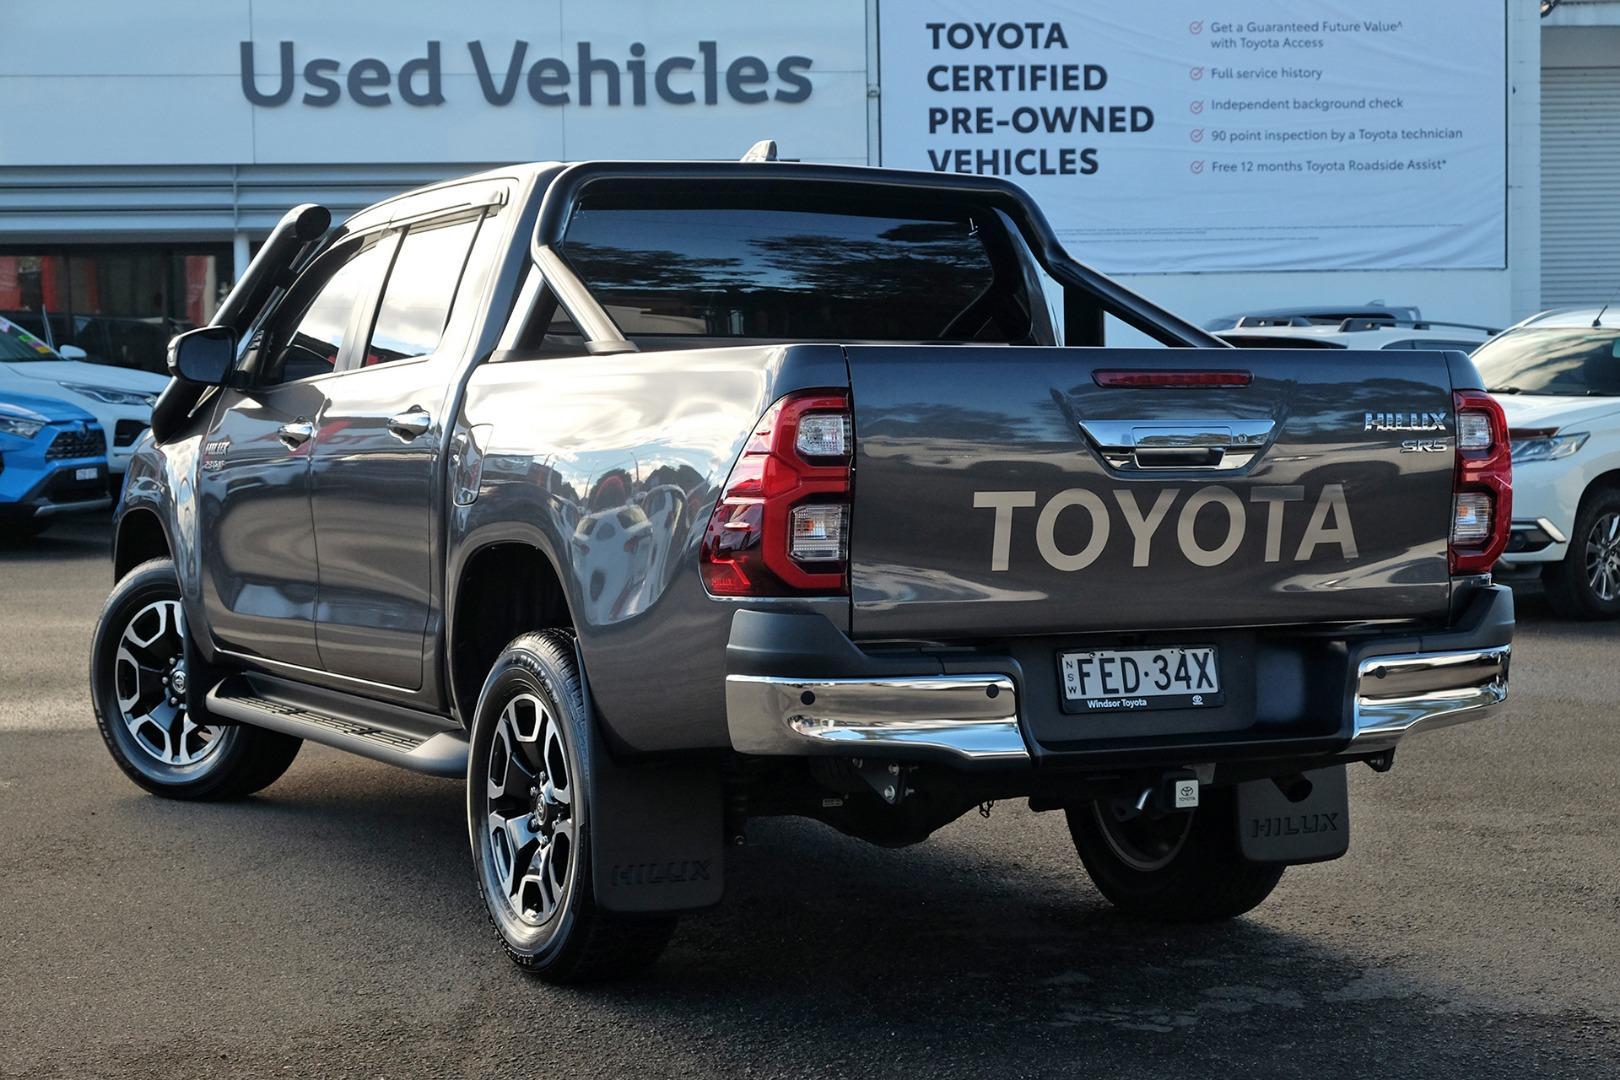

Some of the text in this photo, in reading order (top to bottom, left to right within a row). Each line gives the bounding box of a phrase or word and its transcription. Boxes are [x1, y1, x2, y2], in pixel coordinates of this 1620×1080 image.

[1211, 21, 1234, 33] Get
[1235, 23, 1244, 33] a
[1246, 20, 1320, 33] Guaranteed
[1323, 20, 1361, 33] Future
[926, 22, 1069, 50] TOYOTA
[1211, 37, 1324, 51] with Toyota Access
[240, 39, 813, 108] Used Vehicles
[927, 64, 1108, 92] CERTIFIED
[1212, 67, 1323, 81] Full service history
[1212, 97, 1404, 112] Independent background check
[928, 106, 1155, 134] PRE-OWNED
[1212, 128, 1463, 144] 90 point inspection by a Toyota technician
[927, 147, 1099, 176] VEHICLES
[1212, 161, 1237, 172] Free
[1241, 161, 1254, 172] 12
[1257, 160, 1302, 172] months
[1306, 160, 1346, 174] Toyota
[1349, 160, 1404, 171] Roadside
[1364, 412, 1447, 431] HILUX
[1400, 440, 1448, 453] SR5
[973, 483, 1359, 572] TOYOTA
[1087, 698, 1148, 709] Windsor Toyota
[1252, 812, 1339, 838] HILUX
